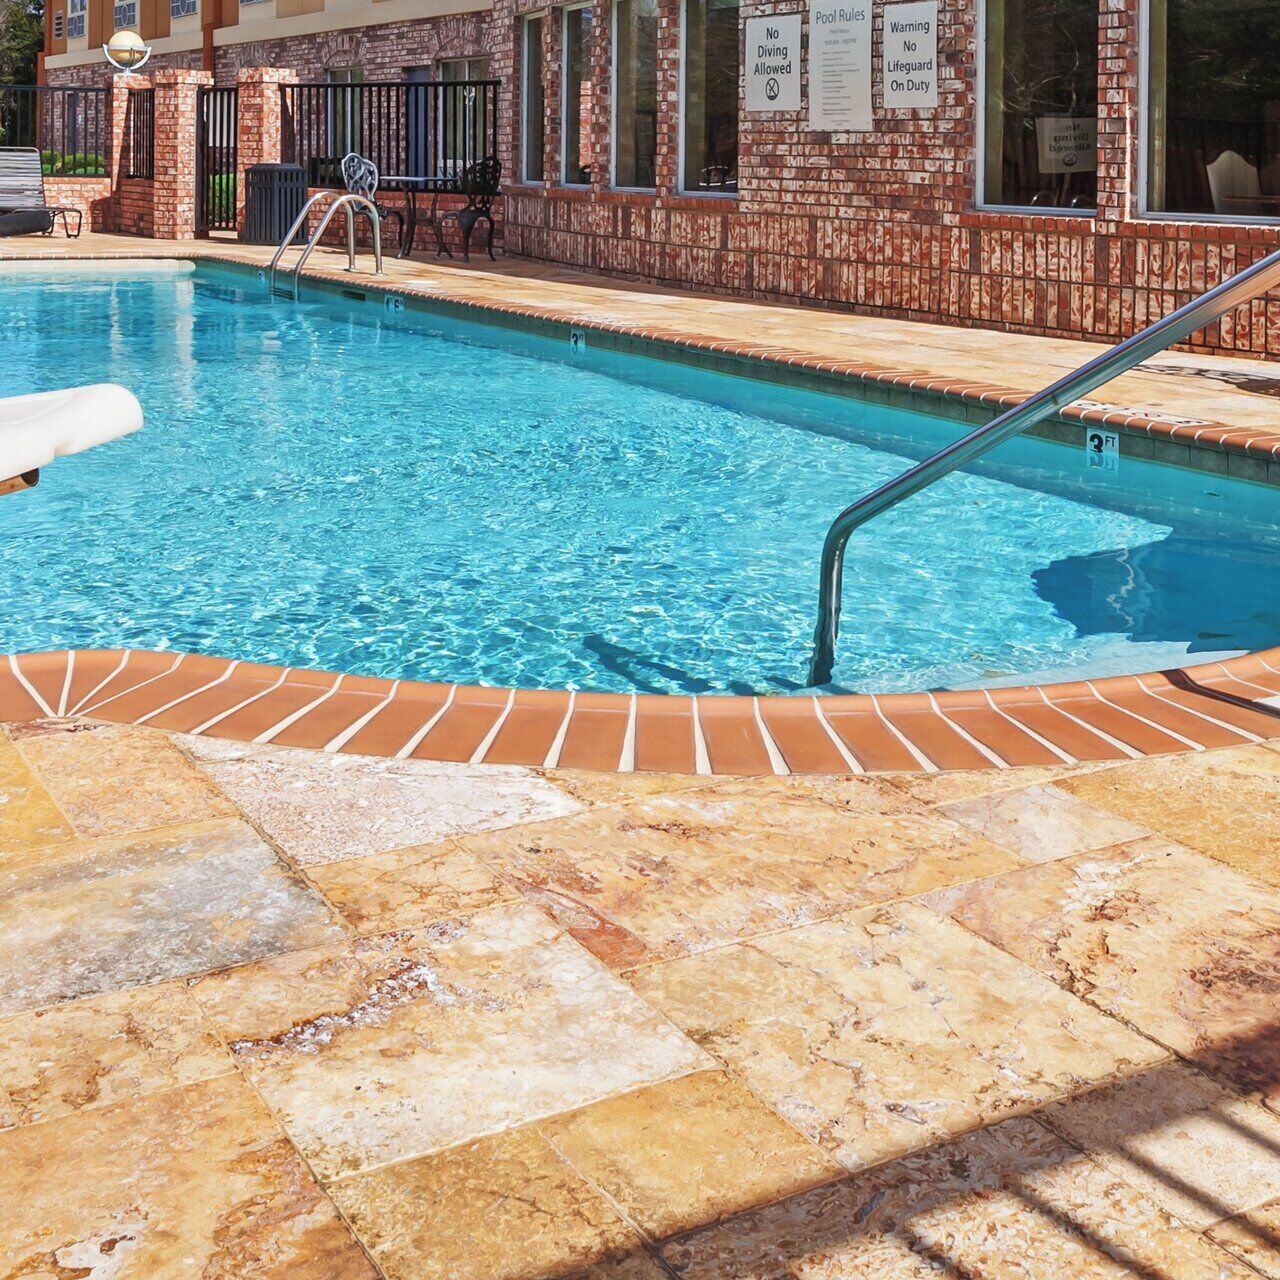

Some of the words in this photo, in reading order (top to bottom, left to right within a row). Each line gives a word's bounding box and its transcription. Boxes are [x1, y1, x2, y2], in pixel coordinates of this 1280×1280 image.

[816, 9, 837, 24] Pool
[839, 7, 865, 22] Rules
[766, 27, 779, 40] No
[890, 20, 930, 34] Warning
[757, 45, 788, 60] Diving
[903, 40, 917, 52] No
[753, 61, 792, 76] Allowed
[887, 58, 933, 74] Lifeguard
[890, 80, 904, 92] On
[906, 79, 930, 94] Duty
